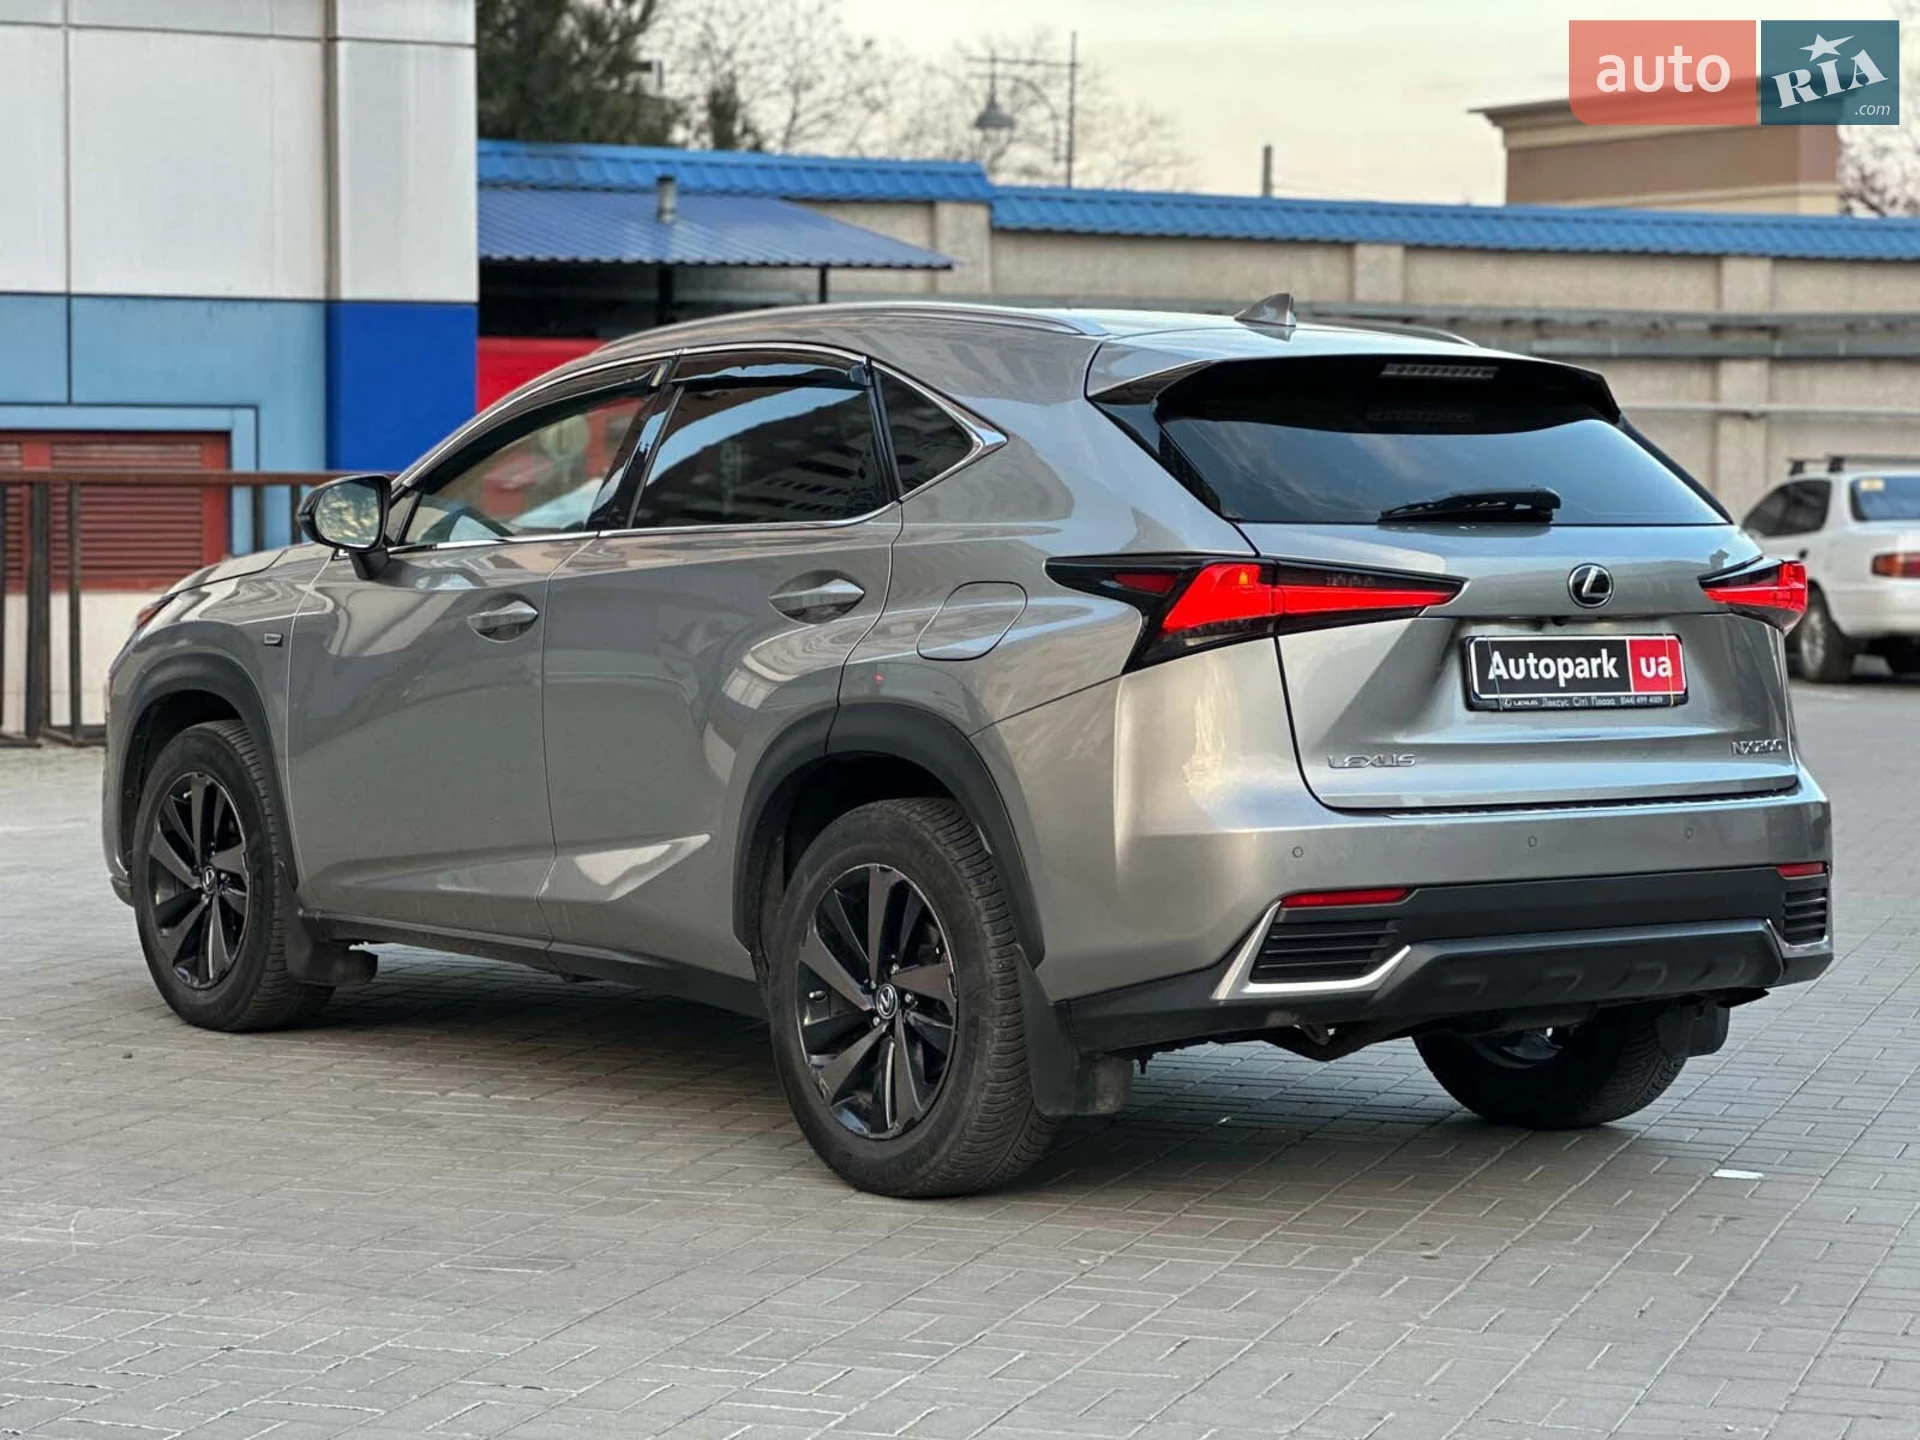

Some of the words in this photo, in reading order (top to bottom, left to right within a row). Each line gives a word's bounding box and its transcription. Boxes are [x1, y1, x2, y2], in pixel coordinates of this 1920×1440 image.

[1487, 648, 1619, 687] Autopark
[1639, 656, 1673, 678] ua
[1327, 754, 1416, 769] LEXUS
